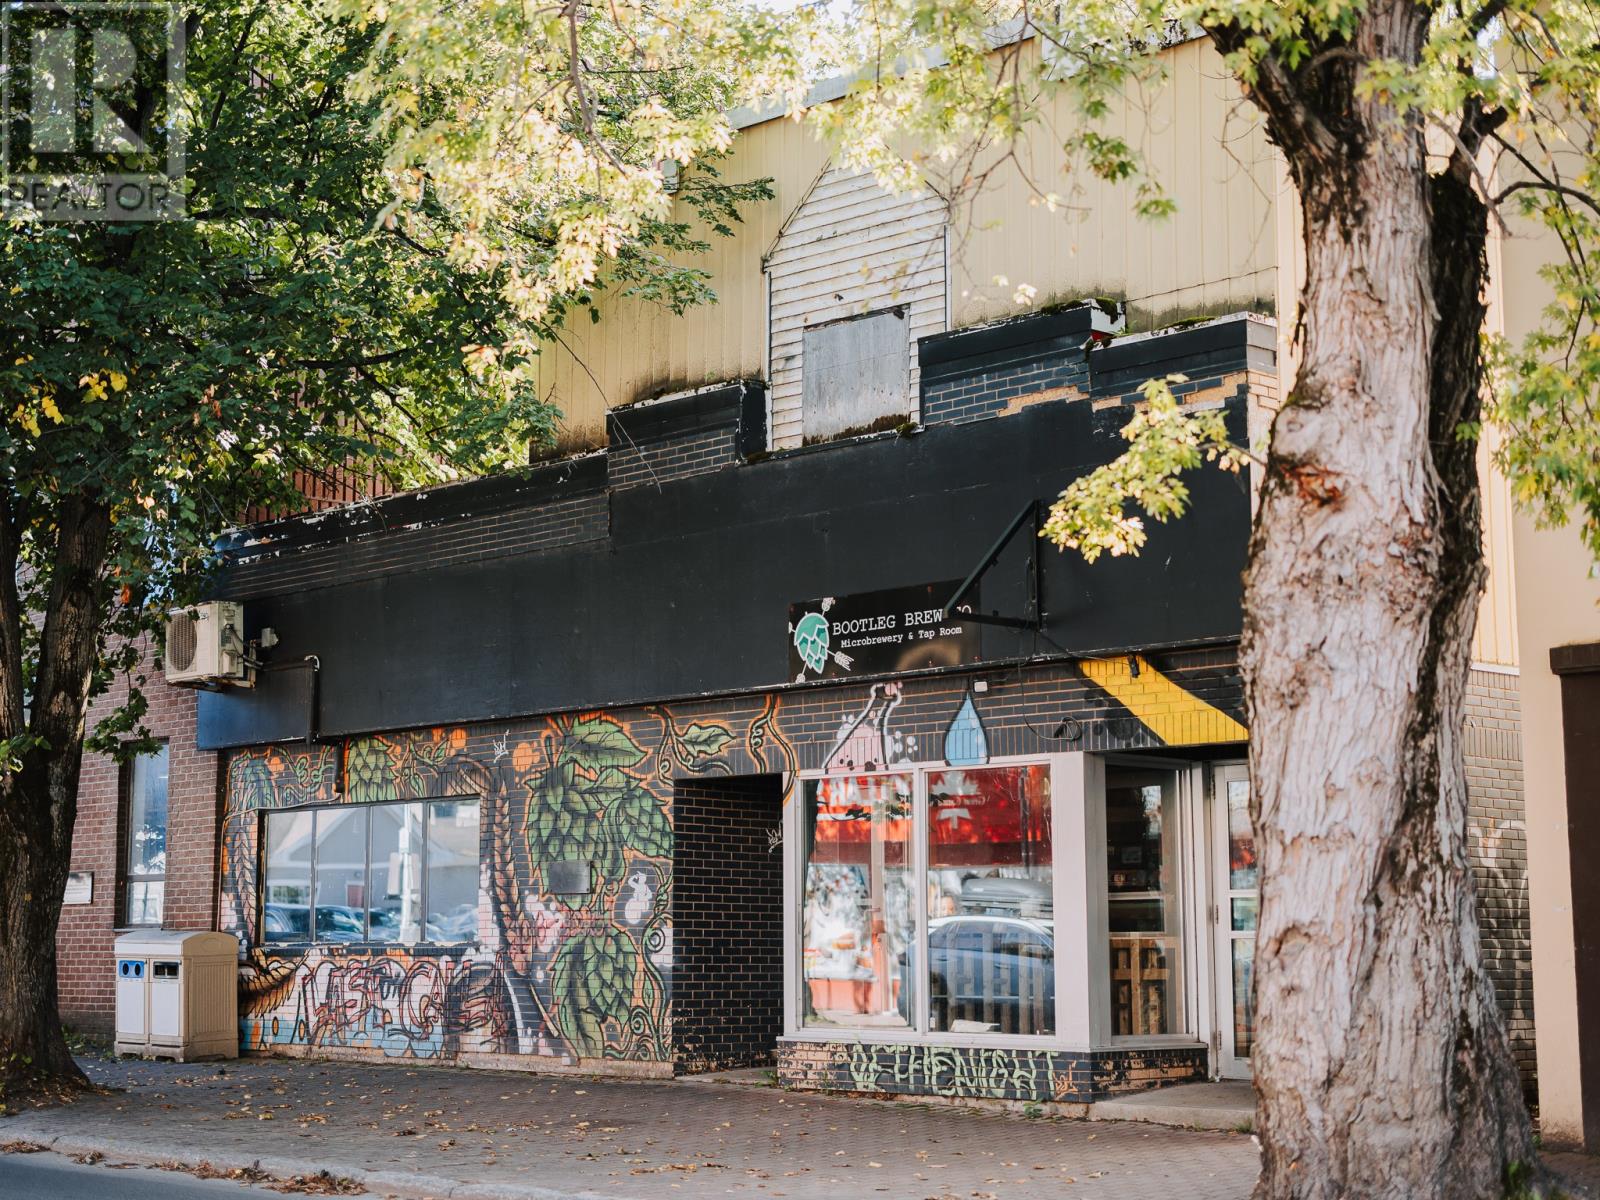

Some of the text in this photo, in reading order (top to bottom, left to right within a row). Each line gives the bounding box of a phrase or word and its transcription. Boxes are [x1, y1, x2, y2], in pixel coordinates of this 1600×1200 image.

[832, 614, 896, 636] BOOTLEG
[904, 608, 943, 626] BREW
[841, 626, 962, 648] Microbrewery & Tap Room
